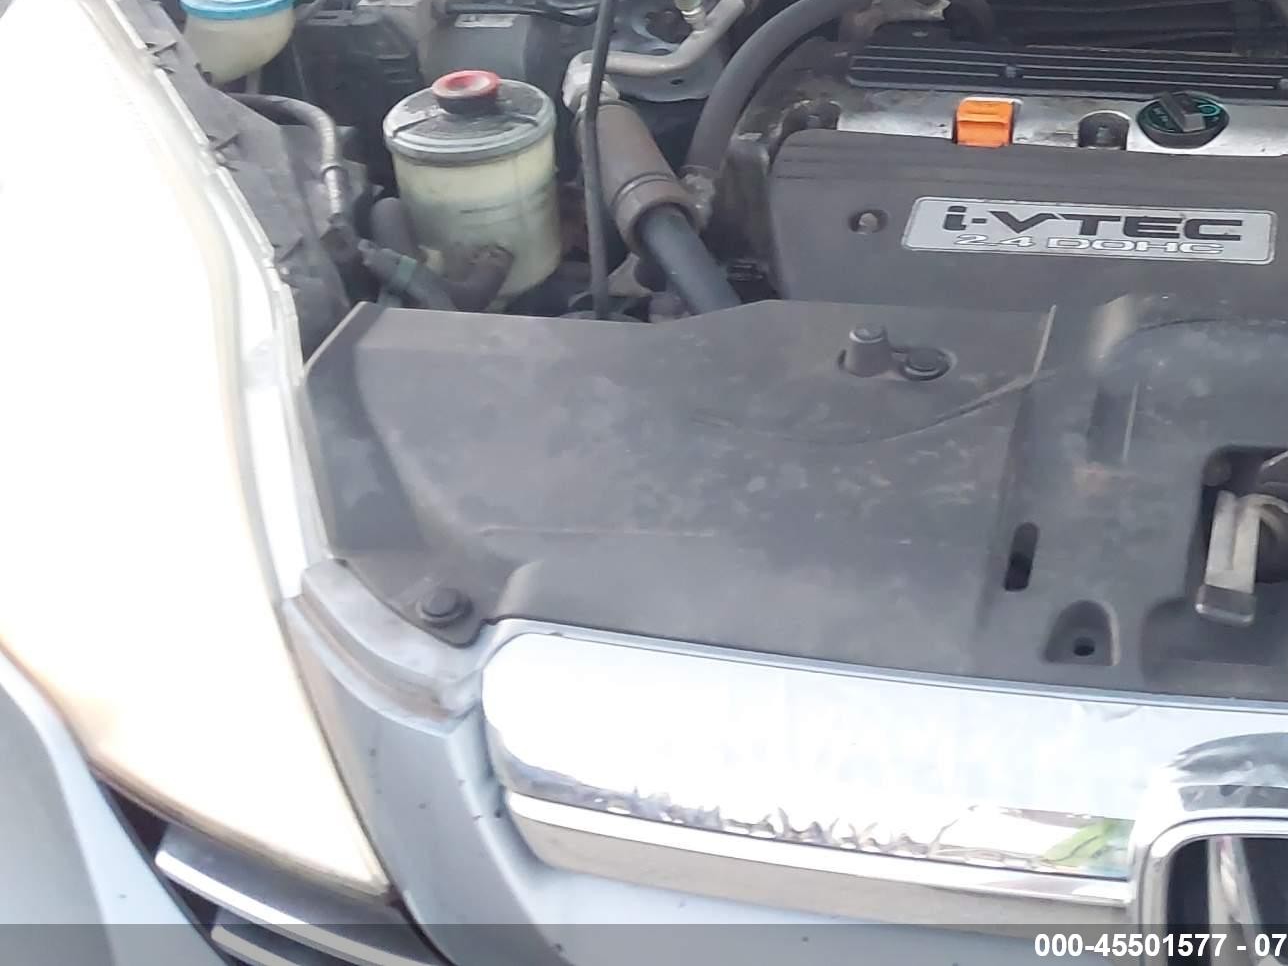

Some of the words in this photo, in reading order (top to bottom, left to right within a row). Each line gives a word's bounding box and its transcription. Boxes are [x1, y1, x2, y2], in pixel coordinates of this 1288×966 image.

[941, 204, 1244, 241] i-VTEC
[953, 234, 1035, 250] 2.4
[1046, 237, 1226, 255] DOHC
